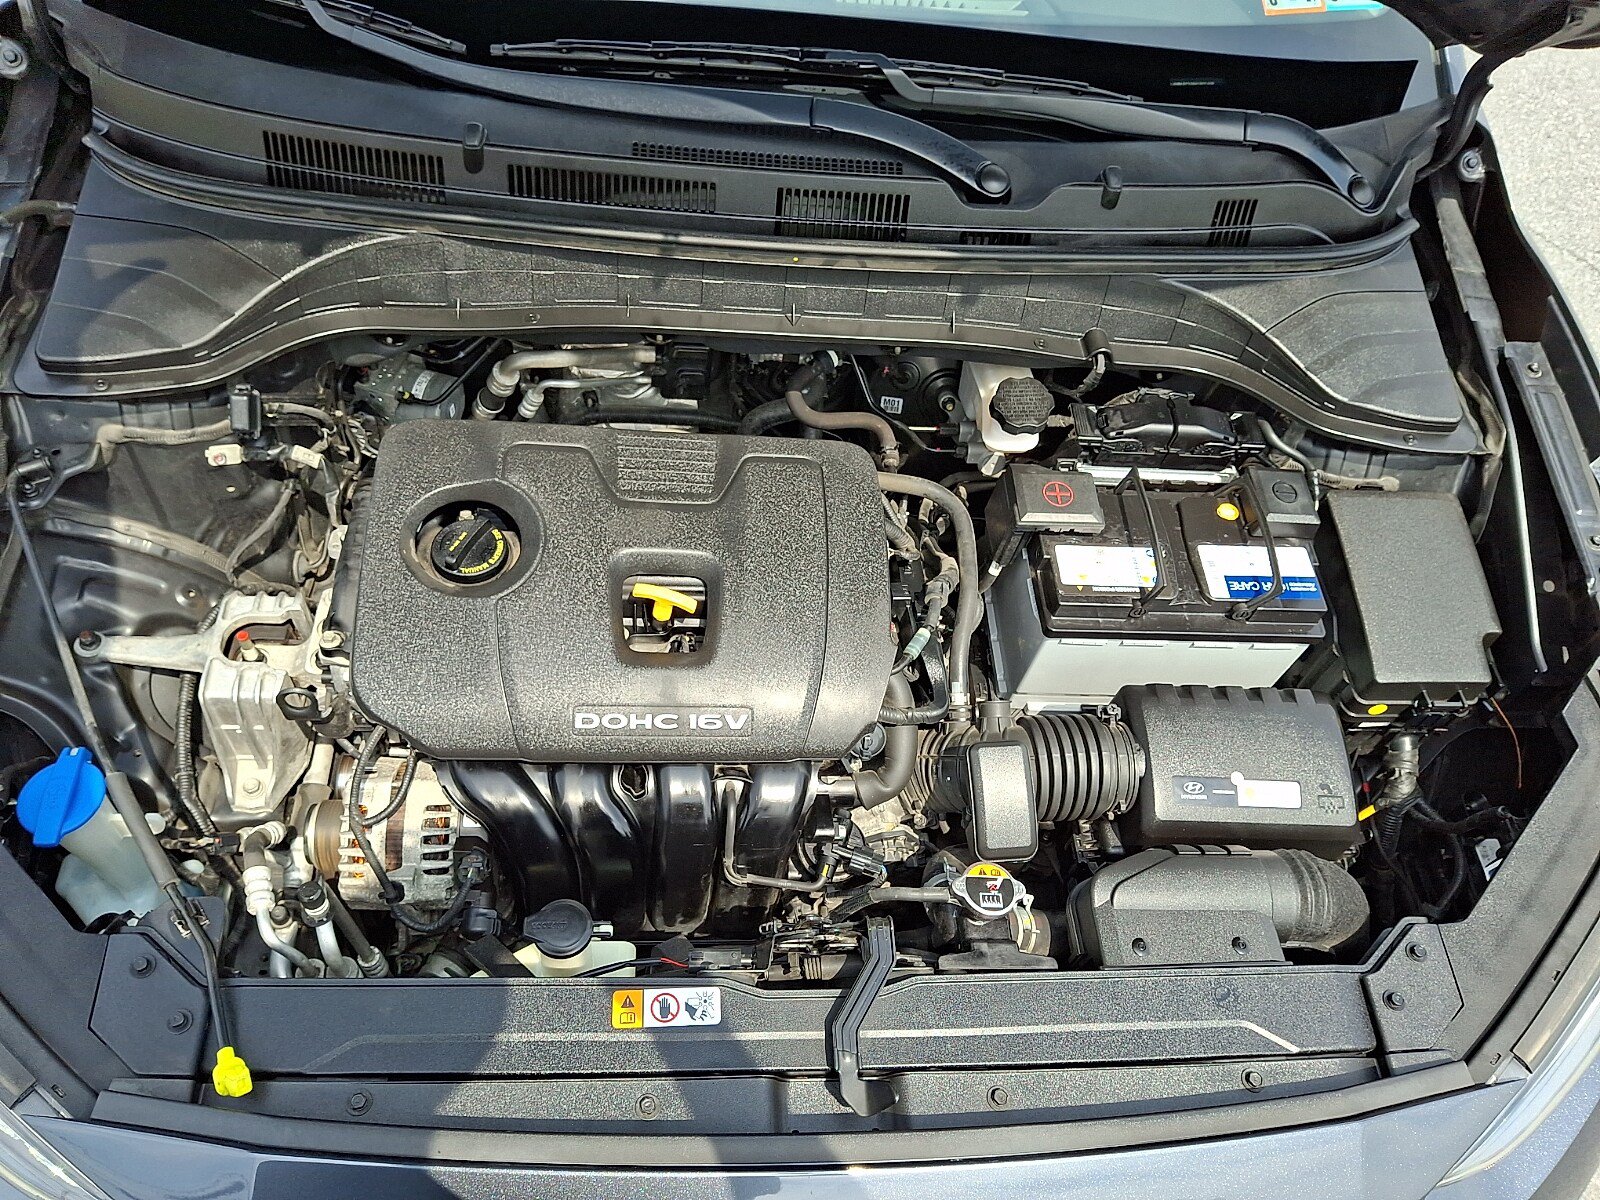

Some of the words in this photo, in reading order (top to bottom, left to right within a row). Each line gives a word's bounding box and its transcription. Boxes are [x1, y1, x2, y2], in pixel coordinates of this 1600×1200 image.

[1228, 581, 1260, 590] CARE
[574, 712, 679, 730] DOHC
[689, 713, 749, 730] 16V
